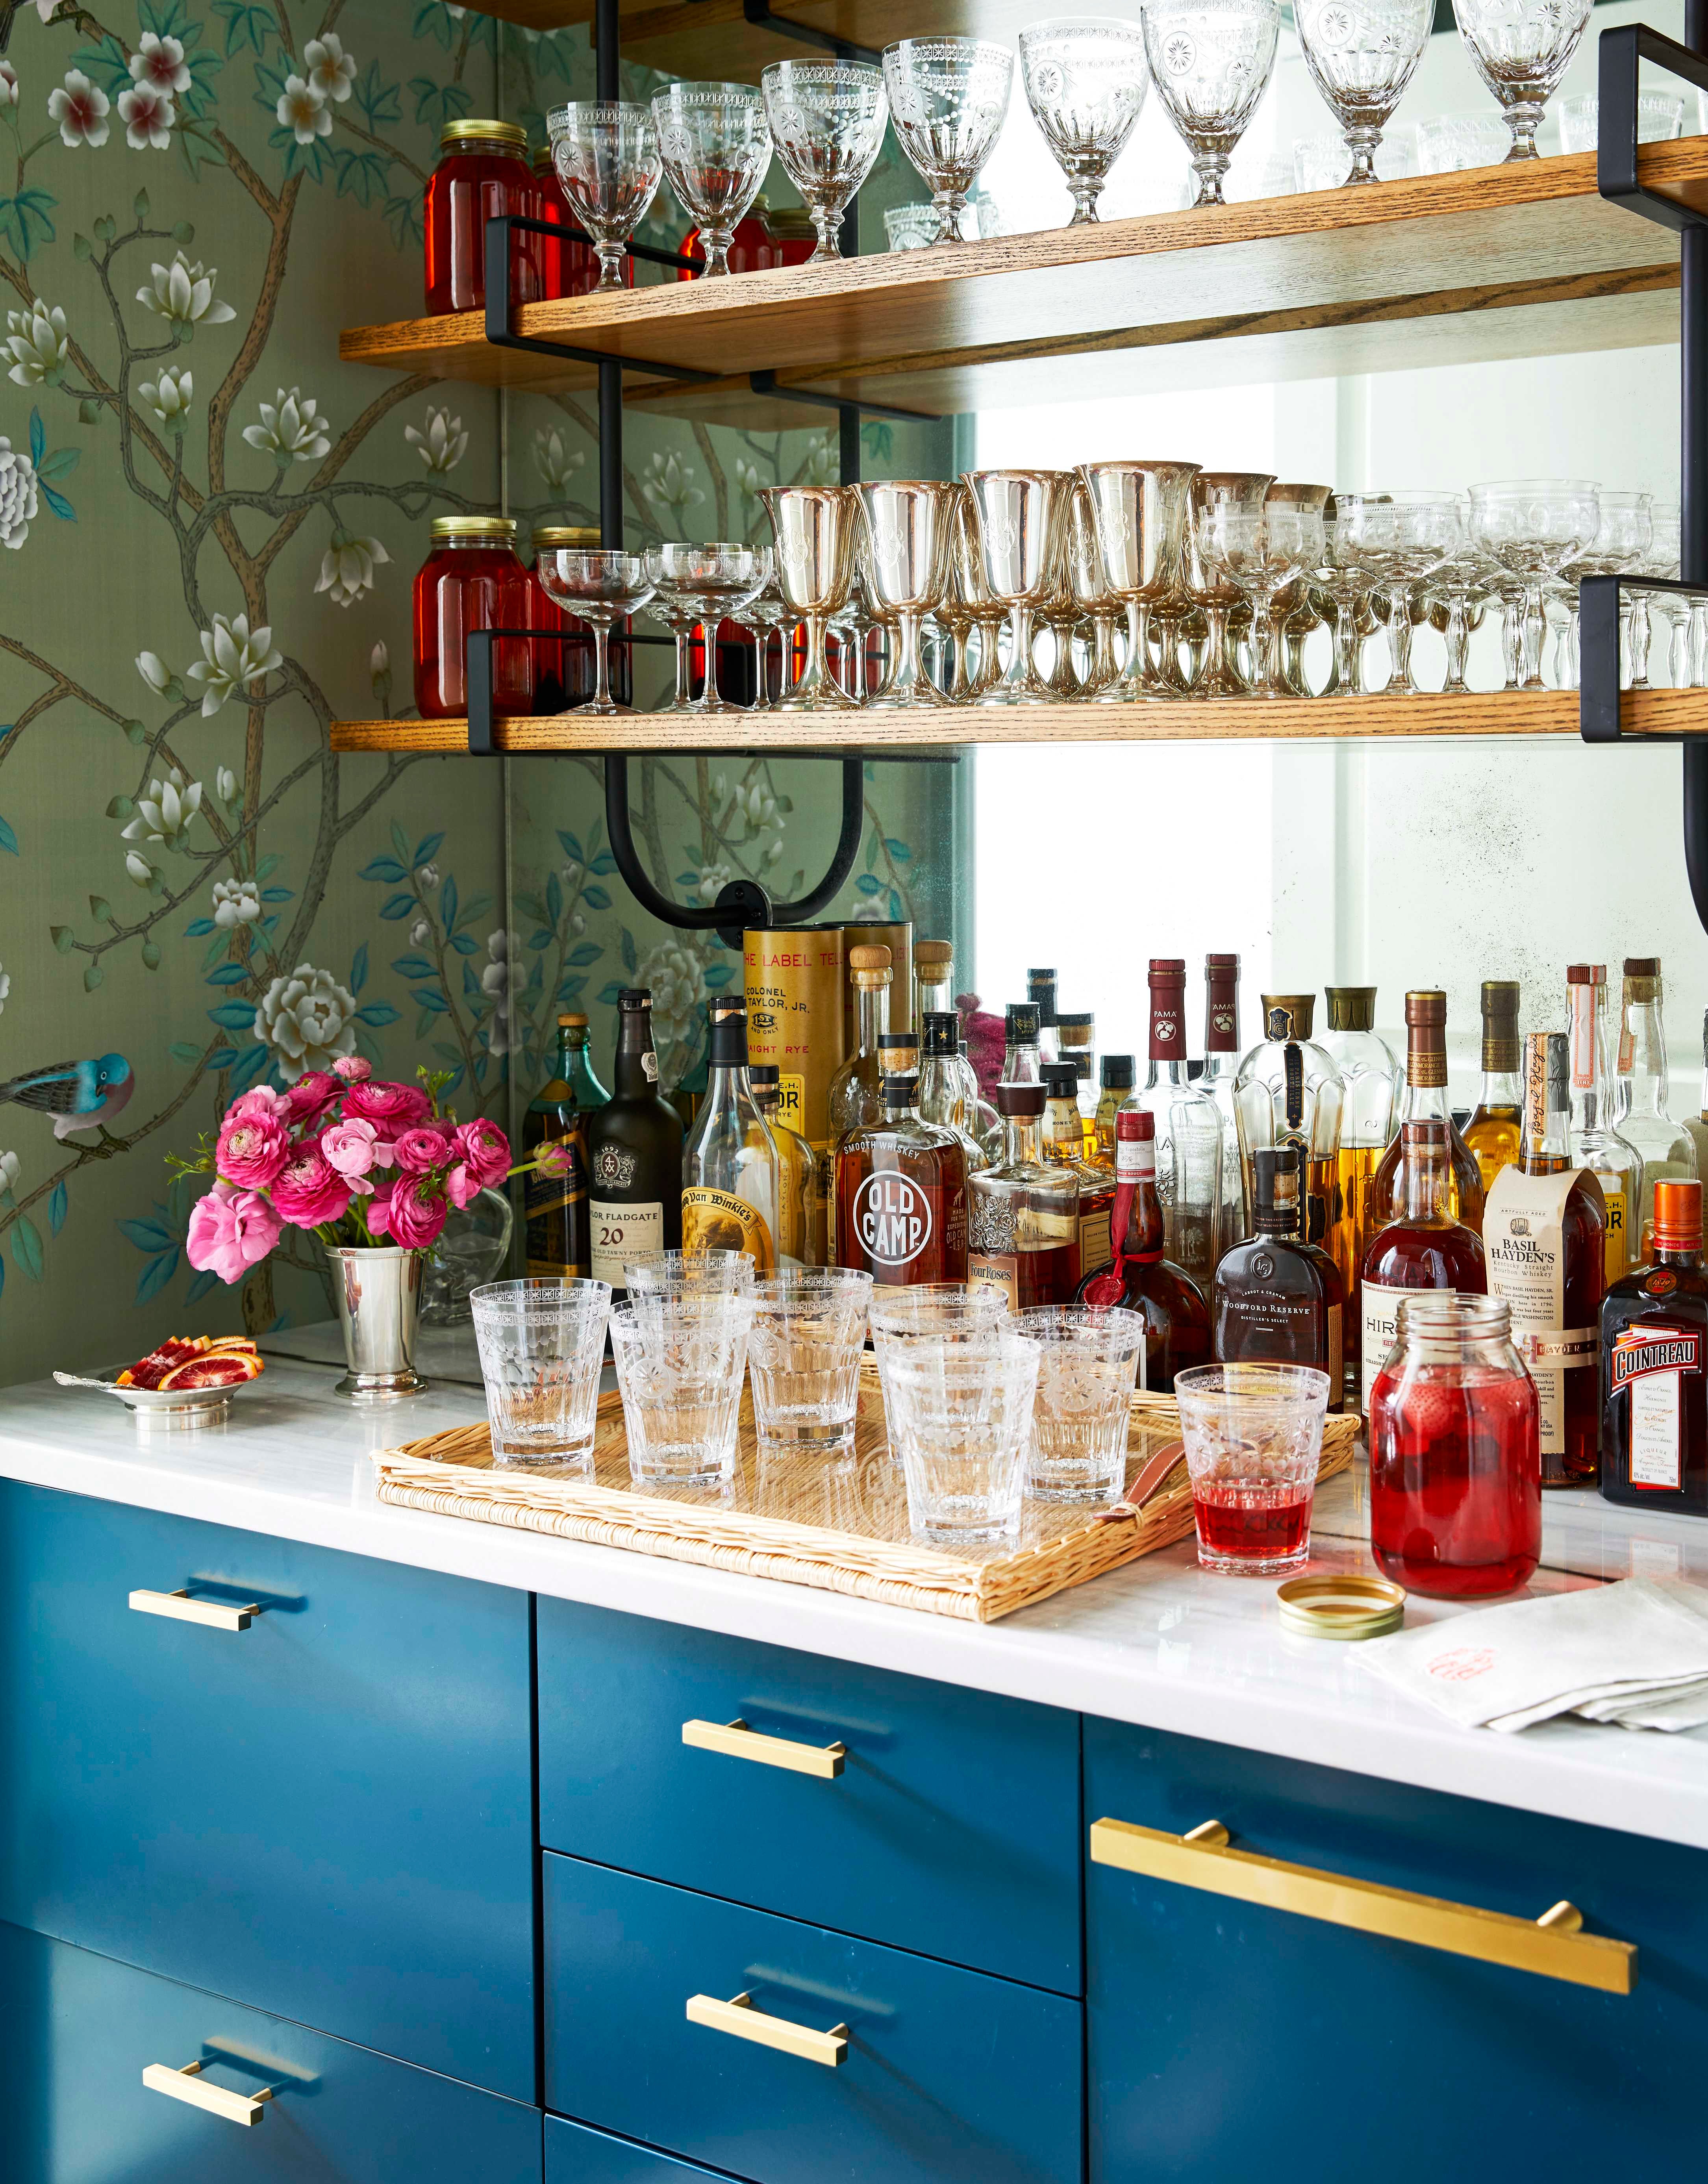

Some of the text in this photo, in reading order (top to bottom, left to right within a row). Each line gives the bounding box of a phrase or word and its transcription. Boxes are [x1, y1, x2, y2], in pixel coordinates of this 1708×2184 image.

[763, 954, 812, 967] LABEL
[747, 987, 786, 997] COLONEL
[748, 998, 810, 1013] TAYLOR, JR.
[763, 1026, 779, 1035] ONLY
[1273, 1022, 1285, 1036] G
[748, 1045, 776, 1053] AIGHT
[602, 1146, 619, 1154] 1692
[843, 1141, 920, 1160] SMOOTH WHISKEY
[869, 1180, 914, 1214] OLD
[689, 1192, 751, 1222] Van Winkle's
[606, 1213, 658, 1221] FLADGATE
[600, 1227, 624, 1246] 20
[863, 1213, 922, 1256] CAMP
[946, 1231, 956, 1244] OLD
[1502, 1238, 1540, 1252] BASIL
[1491, 1248, 1555, 1263] HAYDEN'S
[970, 1262, 1011, 1280] Four Roses
[1493, 1260, 1520, 1270] Kentucky
[1494, 1267, 1518, 1275] Bourbon
[1266, 1290, 1286, 1300] GRAHAM
[1494, 1283, 1512, 1295] WHEN
[1222, 1300, 1310, 1314] WOODFORD RESERVE
[1367, 1317, 1398, 1335] HIR
[1539, 1344, 1580, 1353] HAYDEN
[1615, 1341, 1695, 1381] COINTREAU
[1643, 1394, 1667, 1403] HARMONIE
